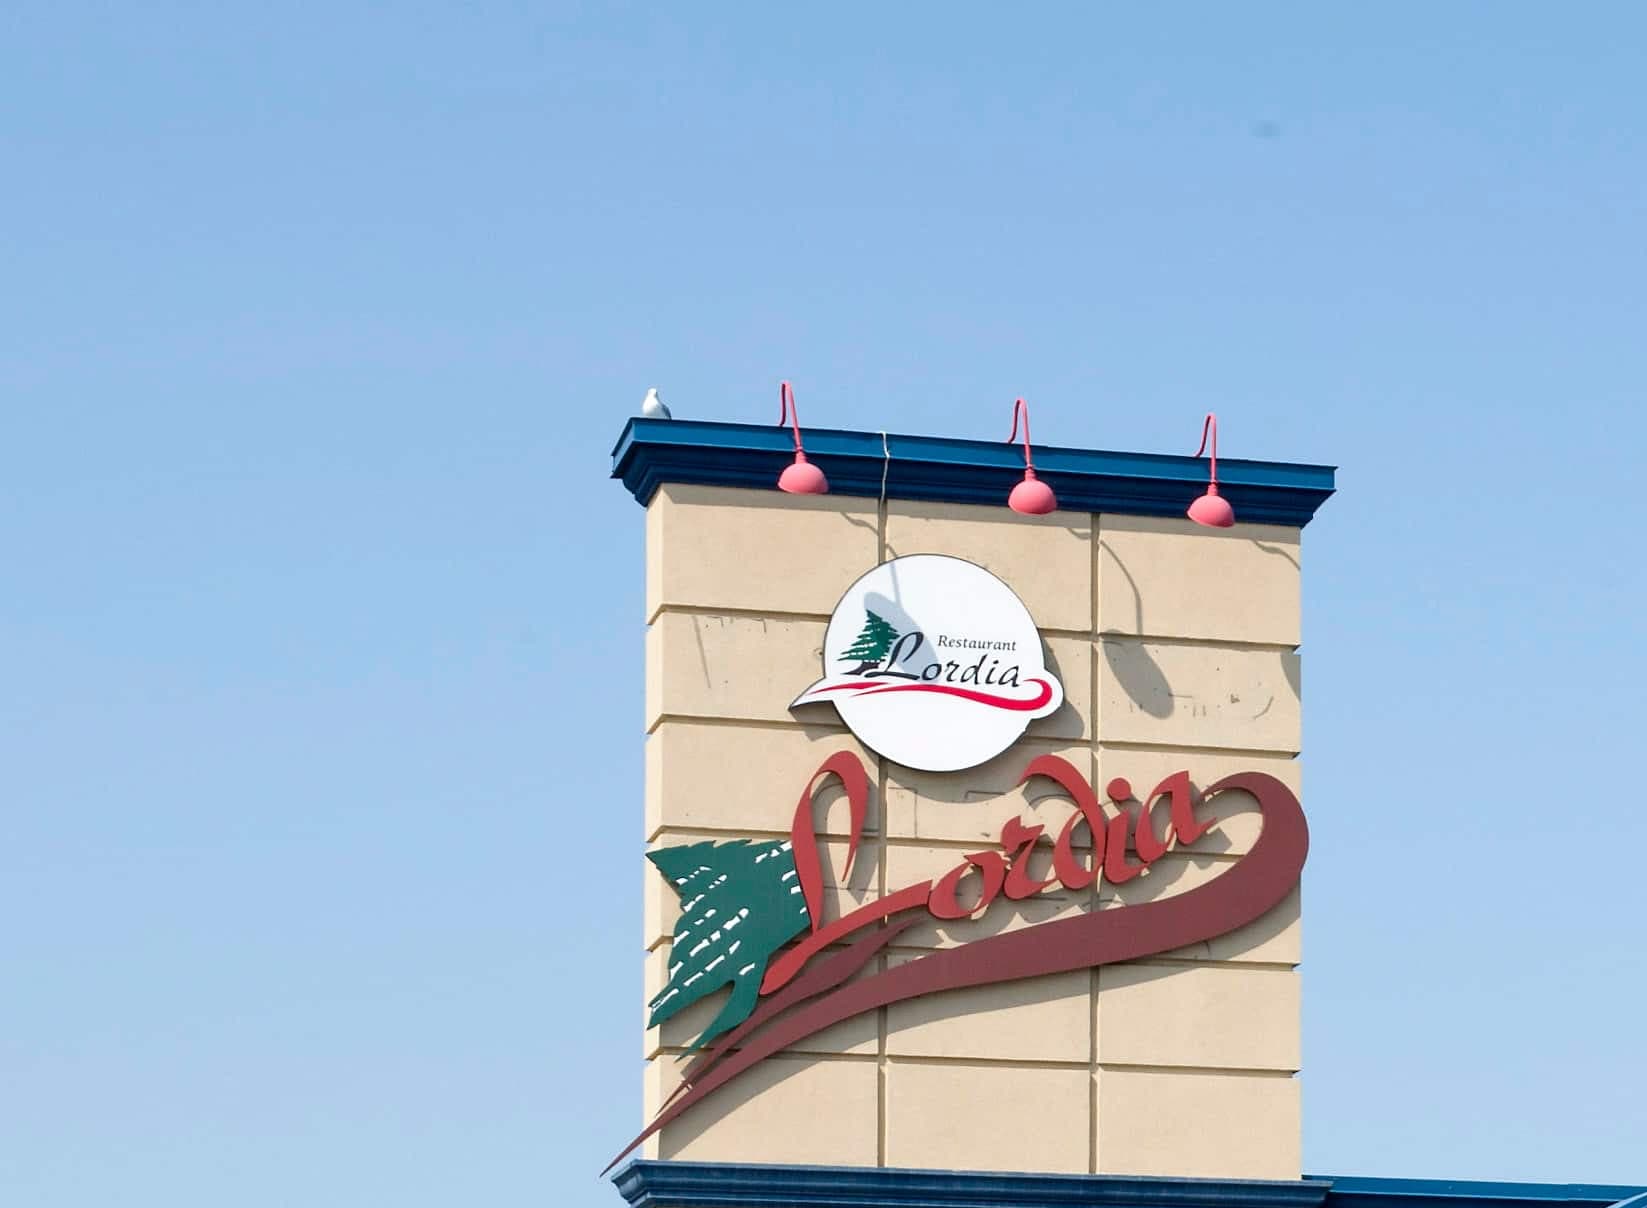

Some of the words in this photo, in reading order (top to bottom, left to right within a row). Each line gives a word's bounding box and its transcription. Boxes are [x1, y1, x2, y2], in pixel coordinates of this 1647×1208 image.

[864, 631, 1020, 688] Lordia
[938, 634, 1017, 651] Restaurant
[760, 750, 1218, 996] Lordia
